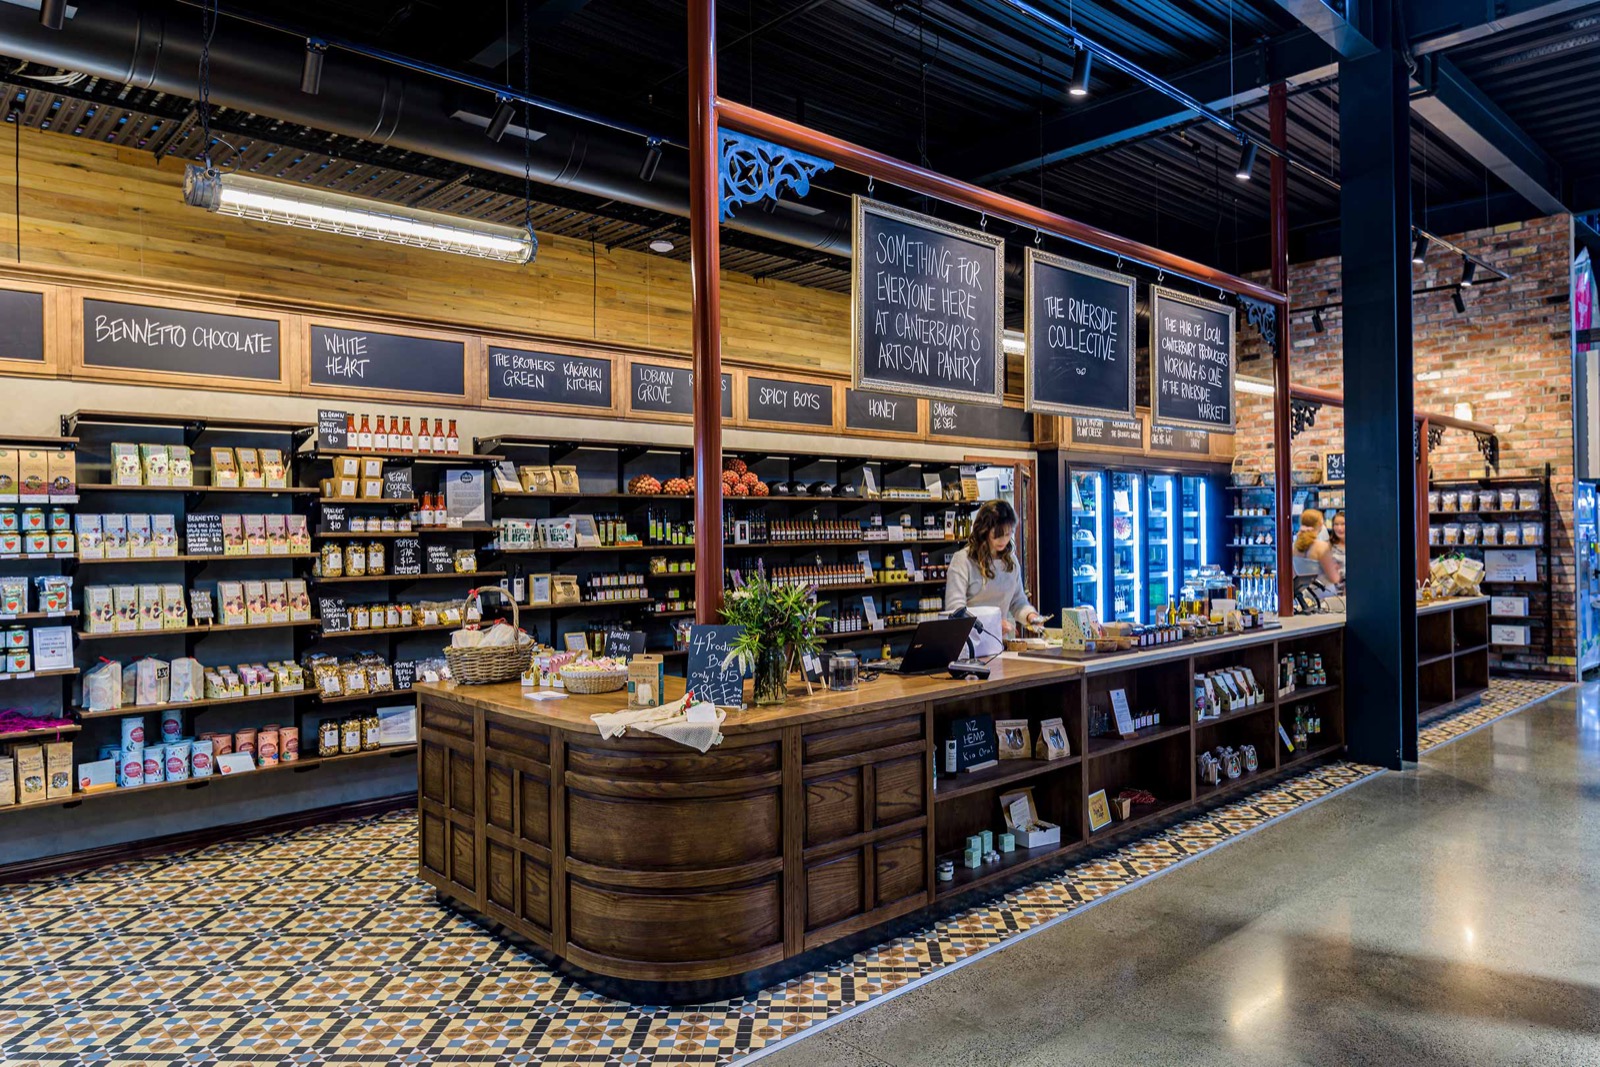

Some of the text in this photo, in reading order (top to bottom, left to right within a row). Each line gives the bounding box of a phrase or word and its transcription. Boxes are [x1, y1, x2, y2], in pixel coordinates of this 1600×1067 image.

[875, 232, 983, 291] SOMETHING FOR
[877, 270, 977, 321] EVERYONE HERE
[1044, 296, 1118, 336] THE RIVERSIDE
[95, 315, 273, 354] BENNETTO CHOCOLATE
[875, 309, 981, 351] AT CANTERBURY'S
[1164, 317, 1225, 346] THE HUB OF LOCAL
[324, 333, 368, 355] WHITE
[1048, 325, 1117, 361] COLLECTIVE
[1161, 337, 1229, 367] CANTERBURY PRODUCERS
[325, 356, 370, 378] HEART
[492, 353, 555, 372] THE BROTHERS
[878, 342, 930, 376] ARTISAN
[503, 369, 544, 388] GREEN
[640, 368, 673, 386] LOBURN
[1163, 356, 1222, 385] WORKING AS ONE
[566, 378, 602, 394] KITCHEN
[637, 383, 672, 403] GROVE
[1162, 379, 1210, 403] AT THE RIVERSIDE
[759, 386, 821, 411] SPICY BOYS
[868, 399, 897, 421] HONEY
[1198, 404, 1226, 421] MARKET
[942, 417, 957, 430] SEL
[386, 483, 411, 492] COOKIES
[388, 472, 408, 482] VEGAN
[330, 521, 341, 531] $10
[395, 539, 420, 549] TOPPER
[693, 634, 706, 656] 4
[692, 670, 739, 683] only! $15
[966, 720, 979, 731] NZ
[963, 731, 986, 744] HEMP
[963, 751, 976, 761] Kia
